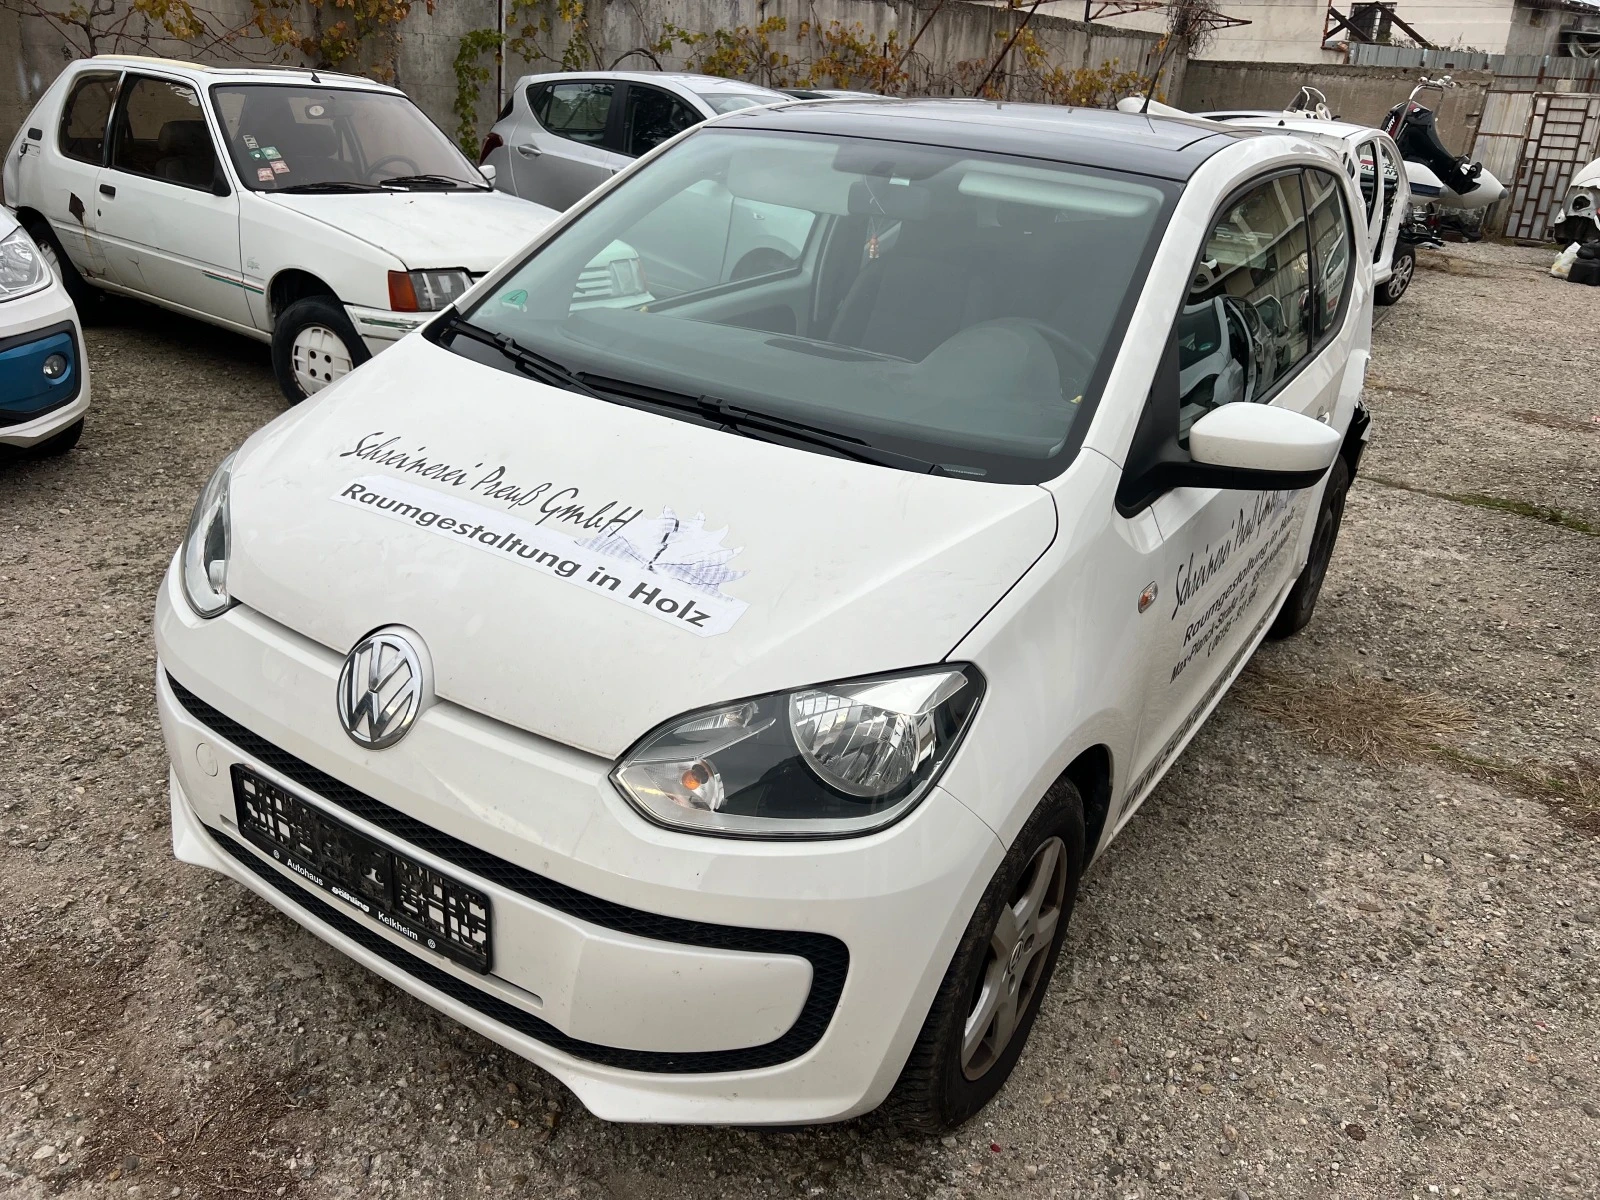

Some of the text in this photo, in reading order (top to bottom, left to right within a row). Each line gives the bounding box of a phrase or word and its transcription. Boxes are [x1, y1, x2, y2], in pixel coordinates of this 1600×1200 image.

[339, 431, 643, 538] Schreinerei Preuß GmbH
[341, 483, 711, 628] Raumgestaltung in Holz
[287, 858, 323, 886] Autohaus
[378, 911, 418, 941] Kelkheim
